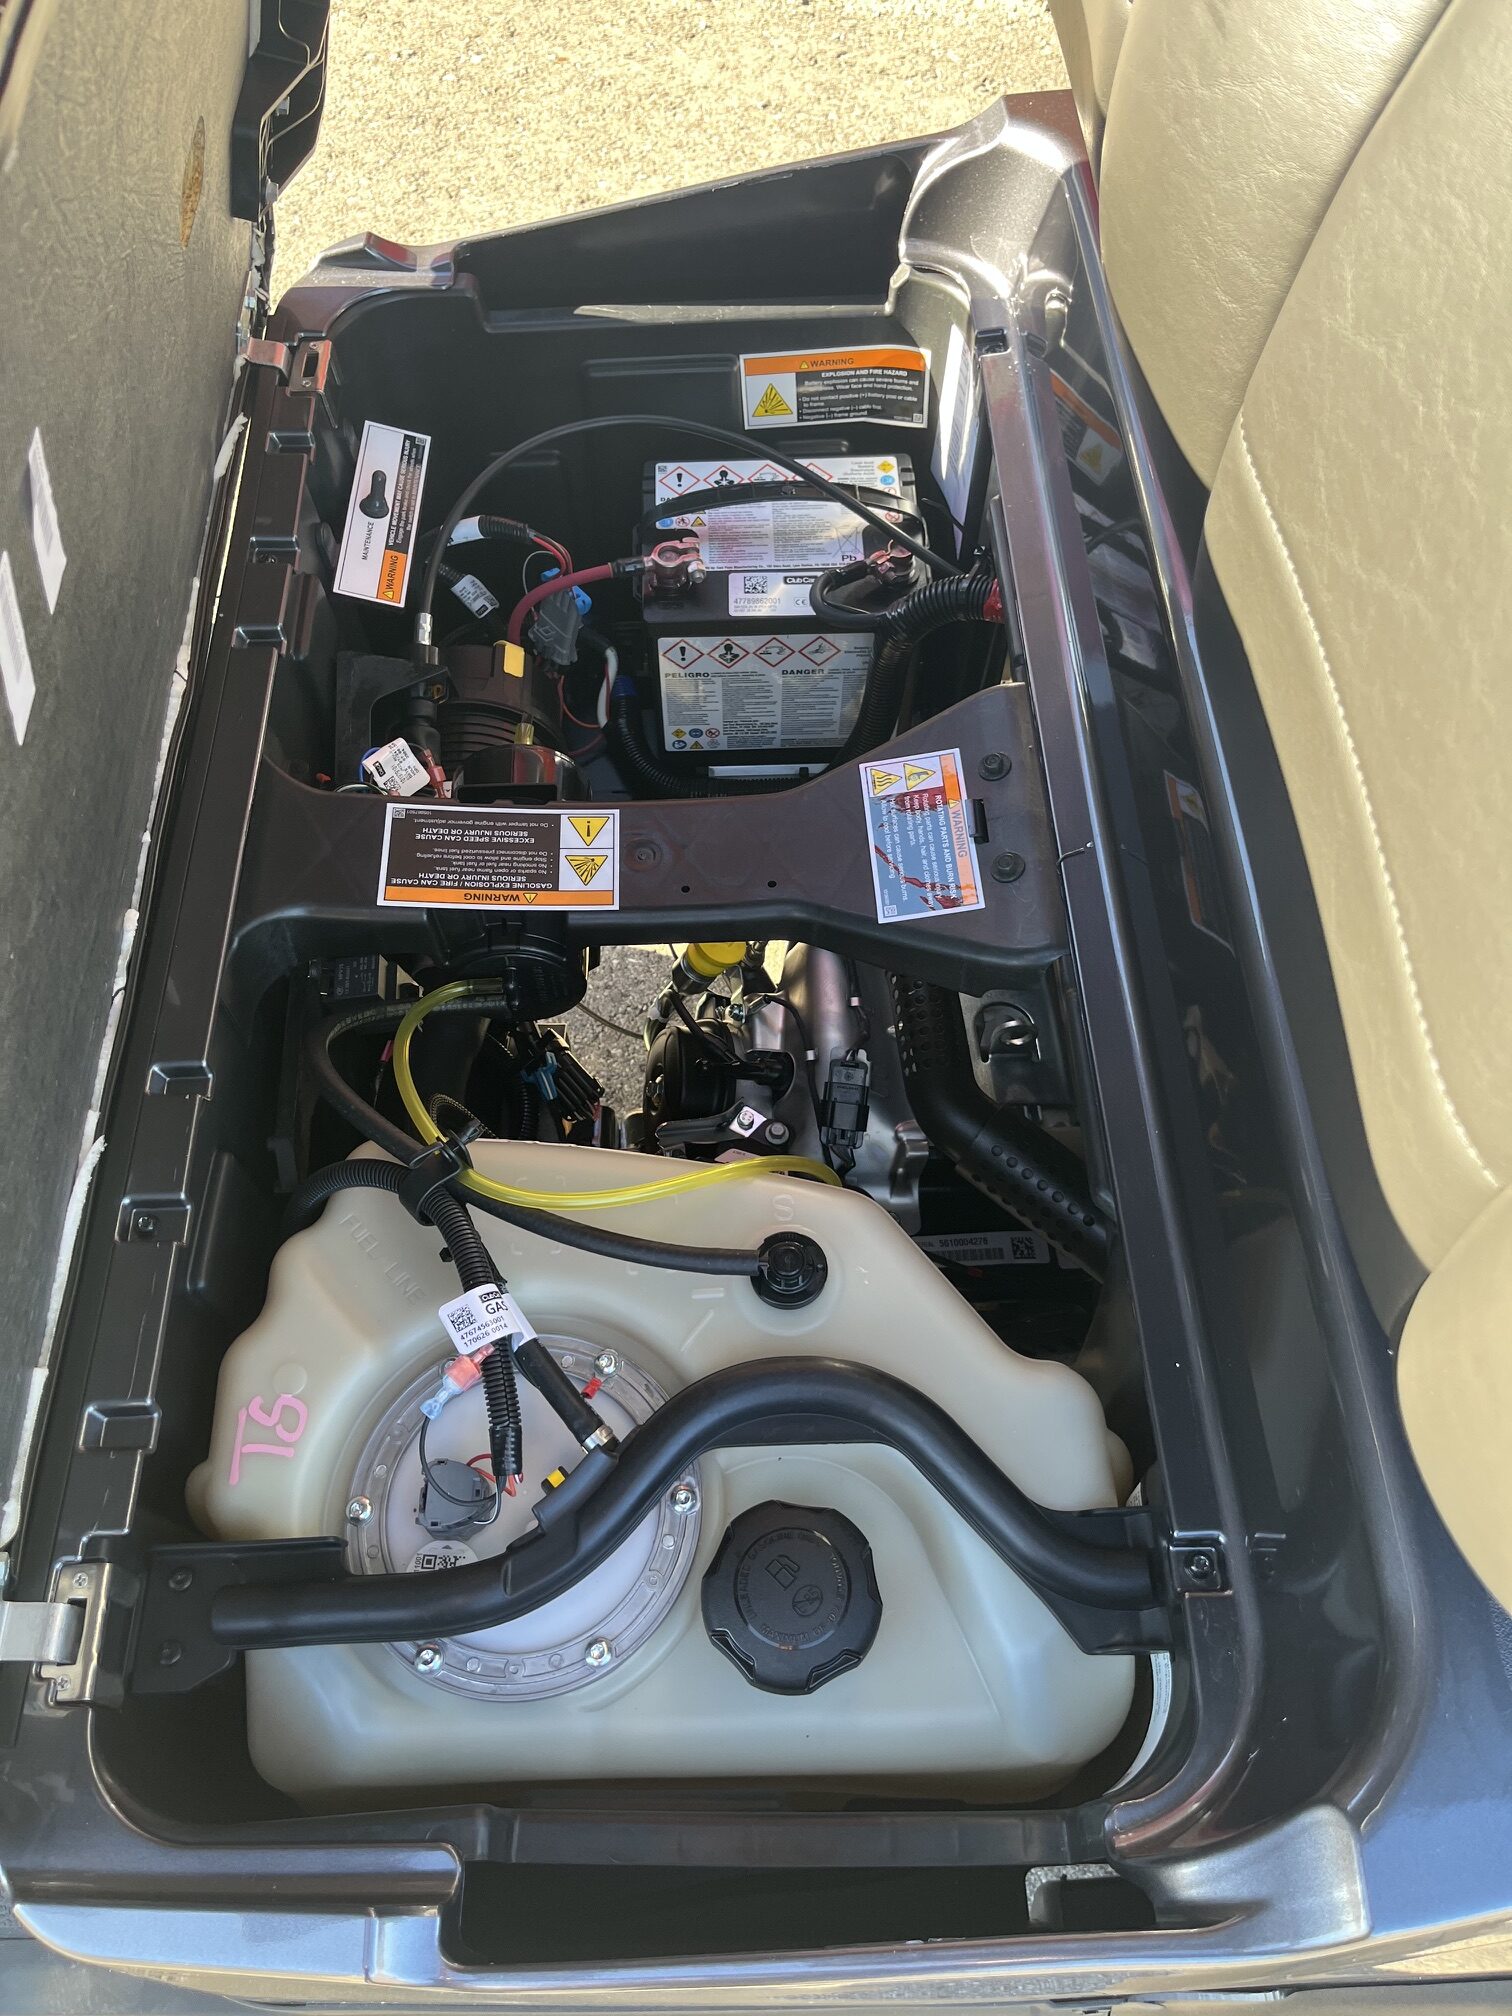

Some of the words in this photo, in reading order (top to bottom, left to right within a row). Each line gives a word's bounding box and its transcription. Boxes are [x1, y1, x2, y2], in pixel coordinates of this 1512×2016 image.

[810, 358, 854, 367] WARNING
[823, 378, 848, 386] explosion
[883, 369, 908, 377] HAZARD
[403, 439, 411, 455] INJURY
[400, 454, 409, 475] SERIOUS
[397, 474, 405, 490] CAUSE
[395, 489, 403, 501] MAY
[391, 499, 401, 526] MOVEMENT
[361, 521, 375, 561] MAINTENANCE
[388, 525, 397, 546] VEHICLE
[395, 527, 405, 544] Engage
[841, 554, 857, 562] Pb
[385, 555, 399, 591] WARNING
[781, 668, 825, 676] DANGER
[880, 799, 888, 815] Allow
[904, 795, 912, 809] from
[912, 794, 921, 810] Keep
[919, 793, 931, 816] Rotating
[934, 794, 947, 827] ROTATING
[904, 809, 915, 831] rotating
[913, 809, 923, 826] body,
[924, 816, 933, 831] parts
[883, 822, 891, 834] cool
[890, 808, 900, 833] surfaces
[895, 844, 903, 862] cause
[916, 825, 926, 846] hands,
[939, 826, 950, 848] PARTS
[951, 810, 968, 858] WARNING
[884, 834, 893, 853] before
[929, 843, 937, 861] cause
[921, 858, 930, 871] and
[943, 848, 952, 863] AND
[931, 861, 941, 882] serious
[945, 863, 955, 883] BURN
[923, 870, 933, 892] clothes
[463, 893, 520, 902] WARNING
[948, 882, 958, 899] RISK
[339, 1214, 379, 1260] FUEL
[384, 1262, 426, 1306] LINE
[485, 1300, 508, 1315] GAS
[460, 1315, 505, 1340] 47674563001
[464, 1330, 490, 1348] 170626
[491, 1322, 508, 1334] 0014
